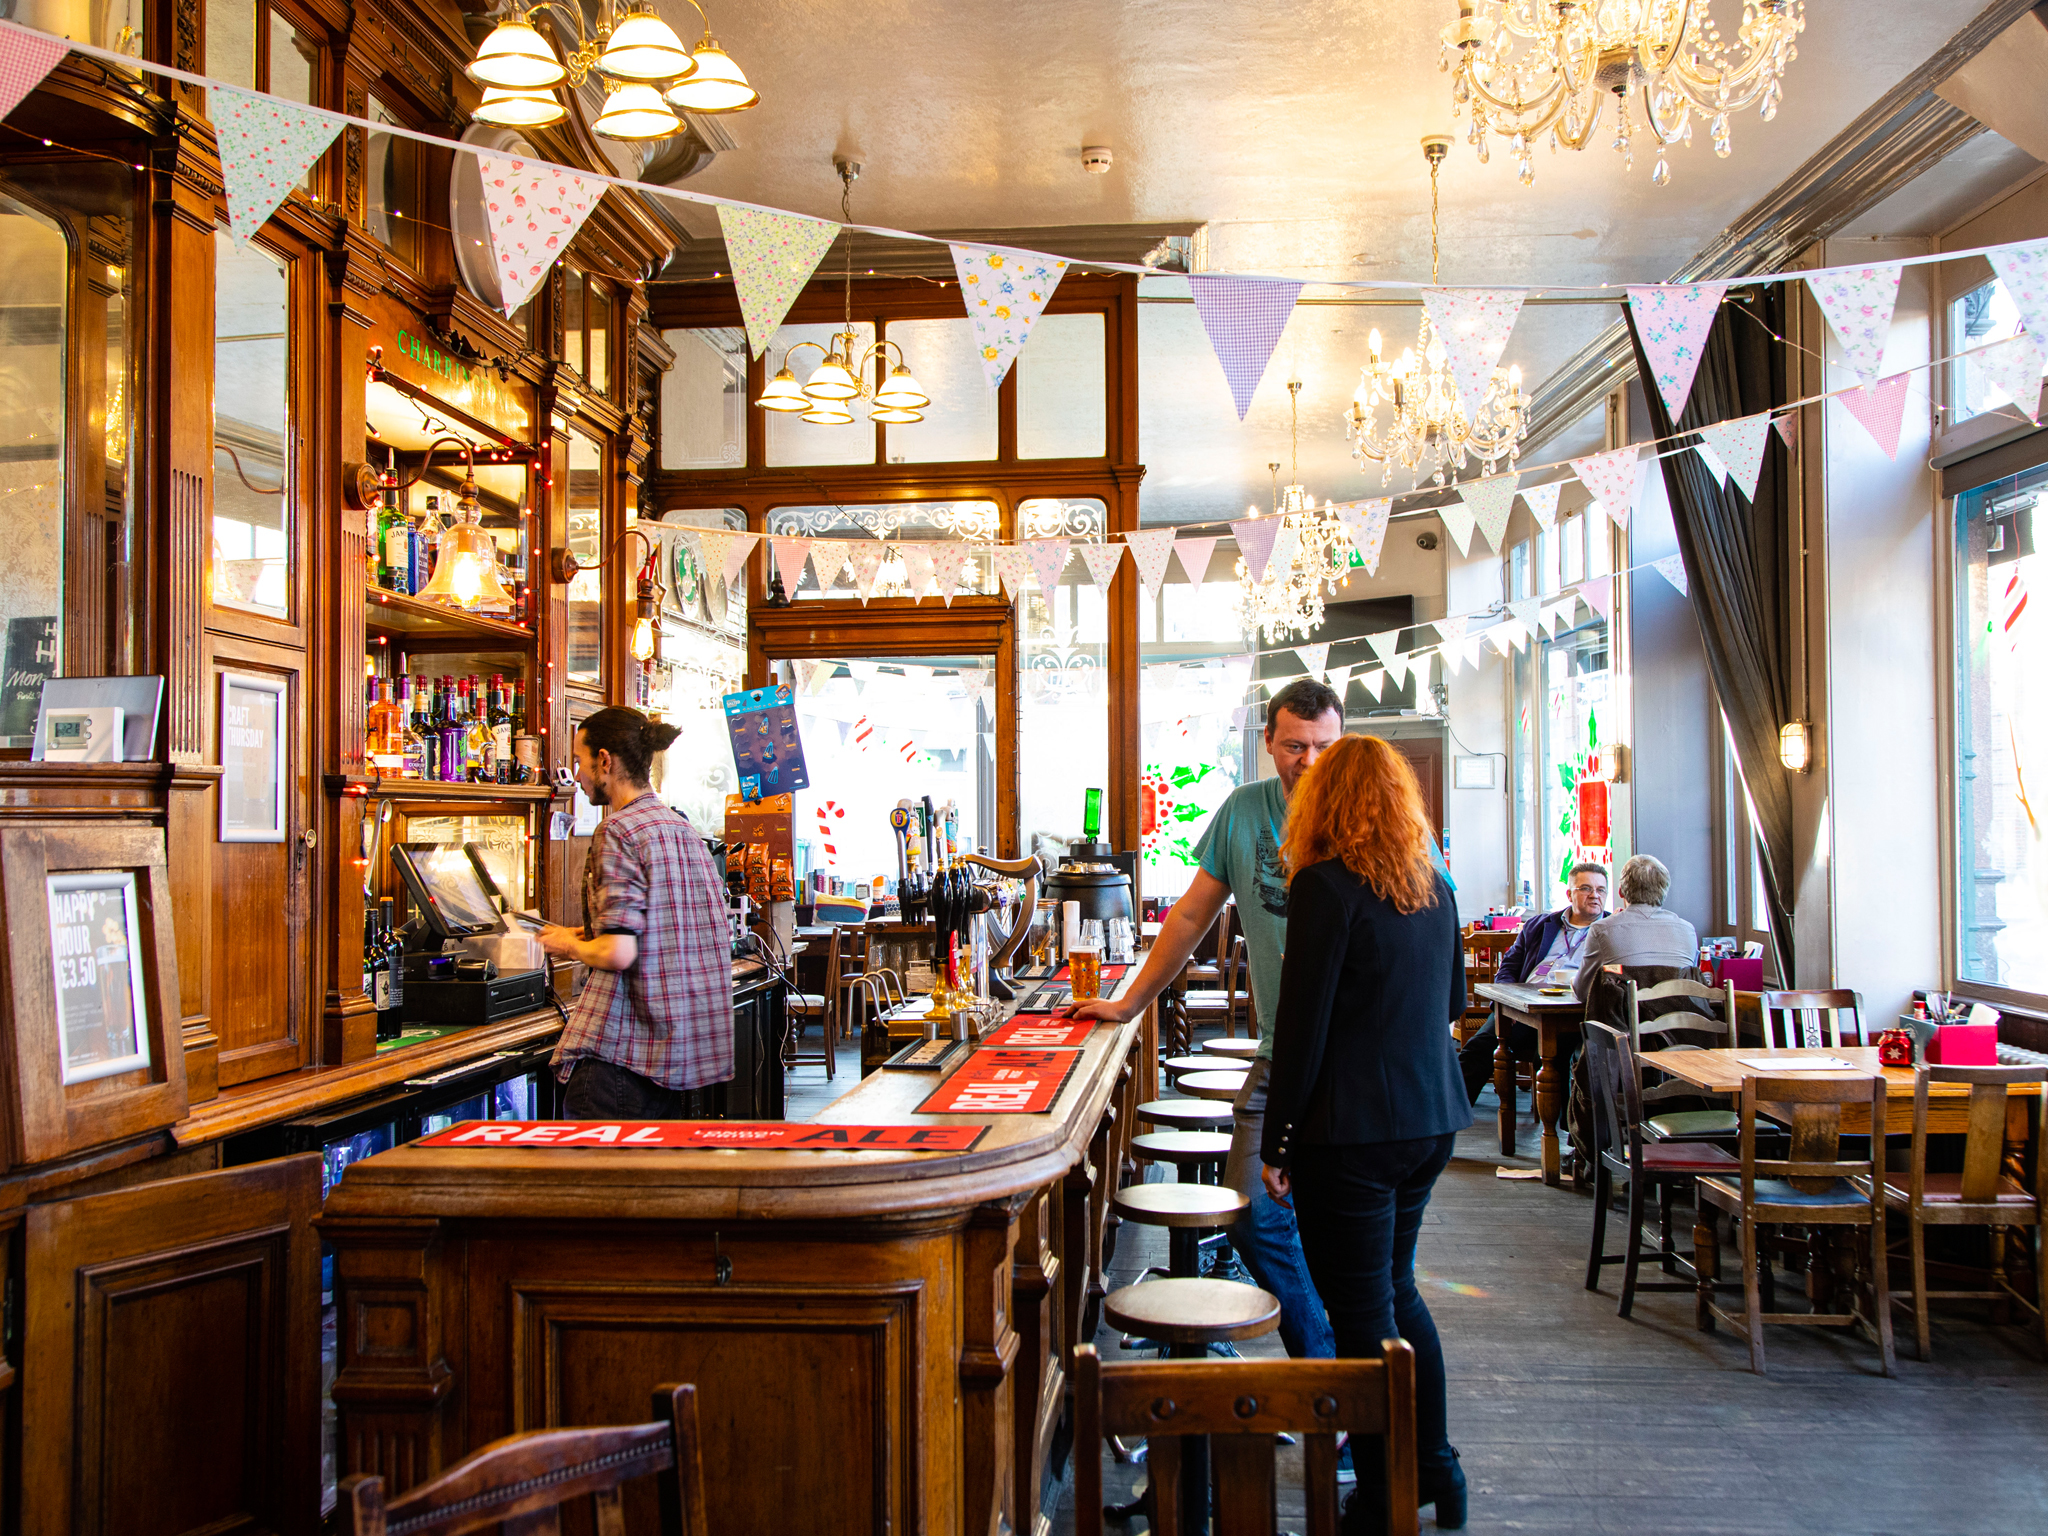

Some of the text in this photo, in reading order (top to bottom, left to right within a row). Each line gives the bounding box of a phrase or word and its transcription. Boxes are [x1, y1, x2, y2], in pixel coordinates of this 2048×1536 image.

[397, 329, 508, 411] CHARRINGTON
[54, 892, 95, 925] HAPPY
[57, 925, 91, 957] HOUR
[60, 956, 97, 990] £3.50
[1004, 1026, 1075, 1044] REAL
[987, 1052, 1057, 1068] ALE
[948, 1080, 1040, 1110] REAL
[450, 1125, 665, 1143] REAL
[791, 1129, 959, 1144] ALE
